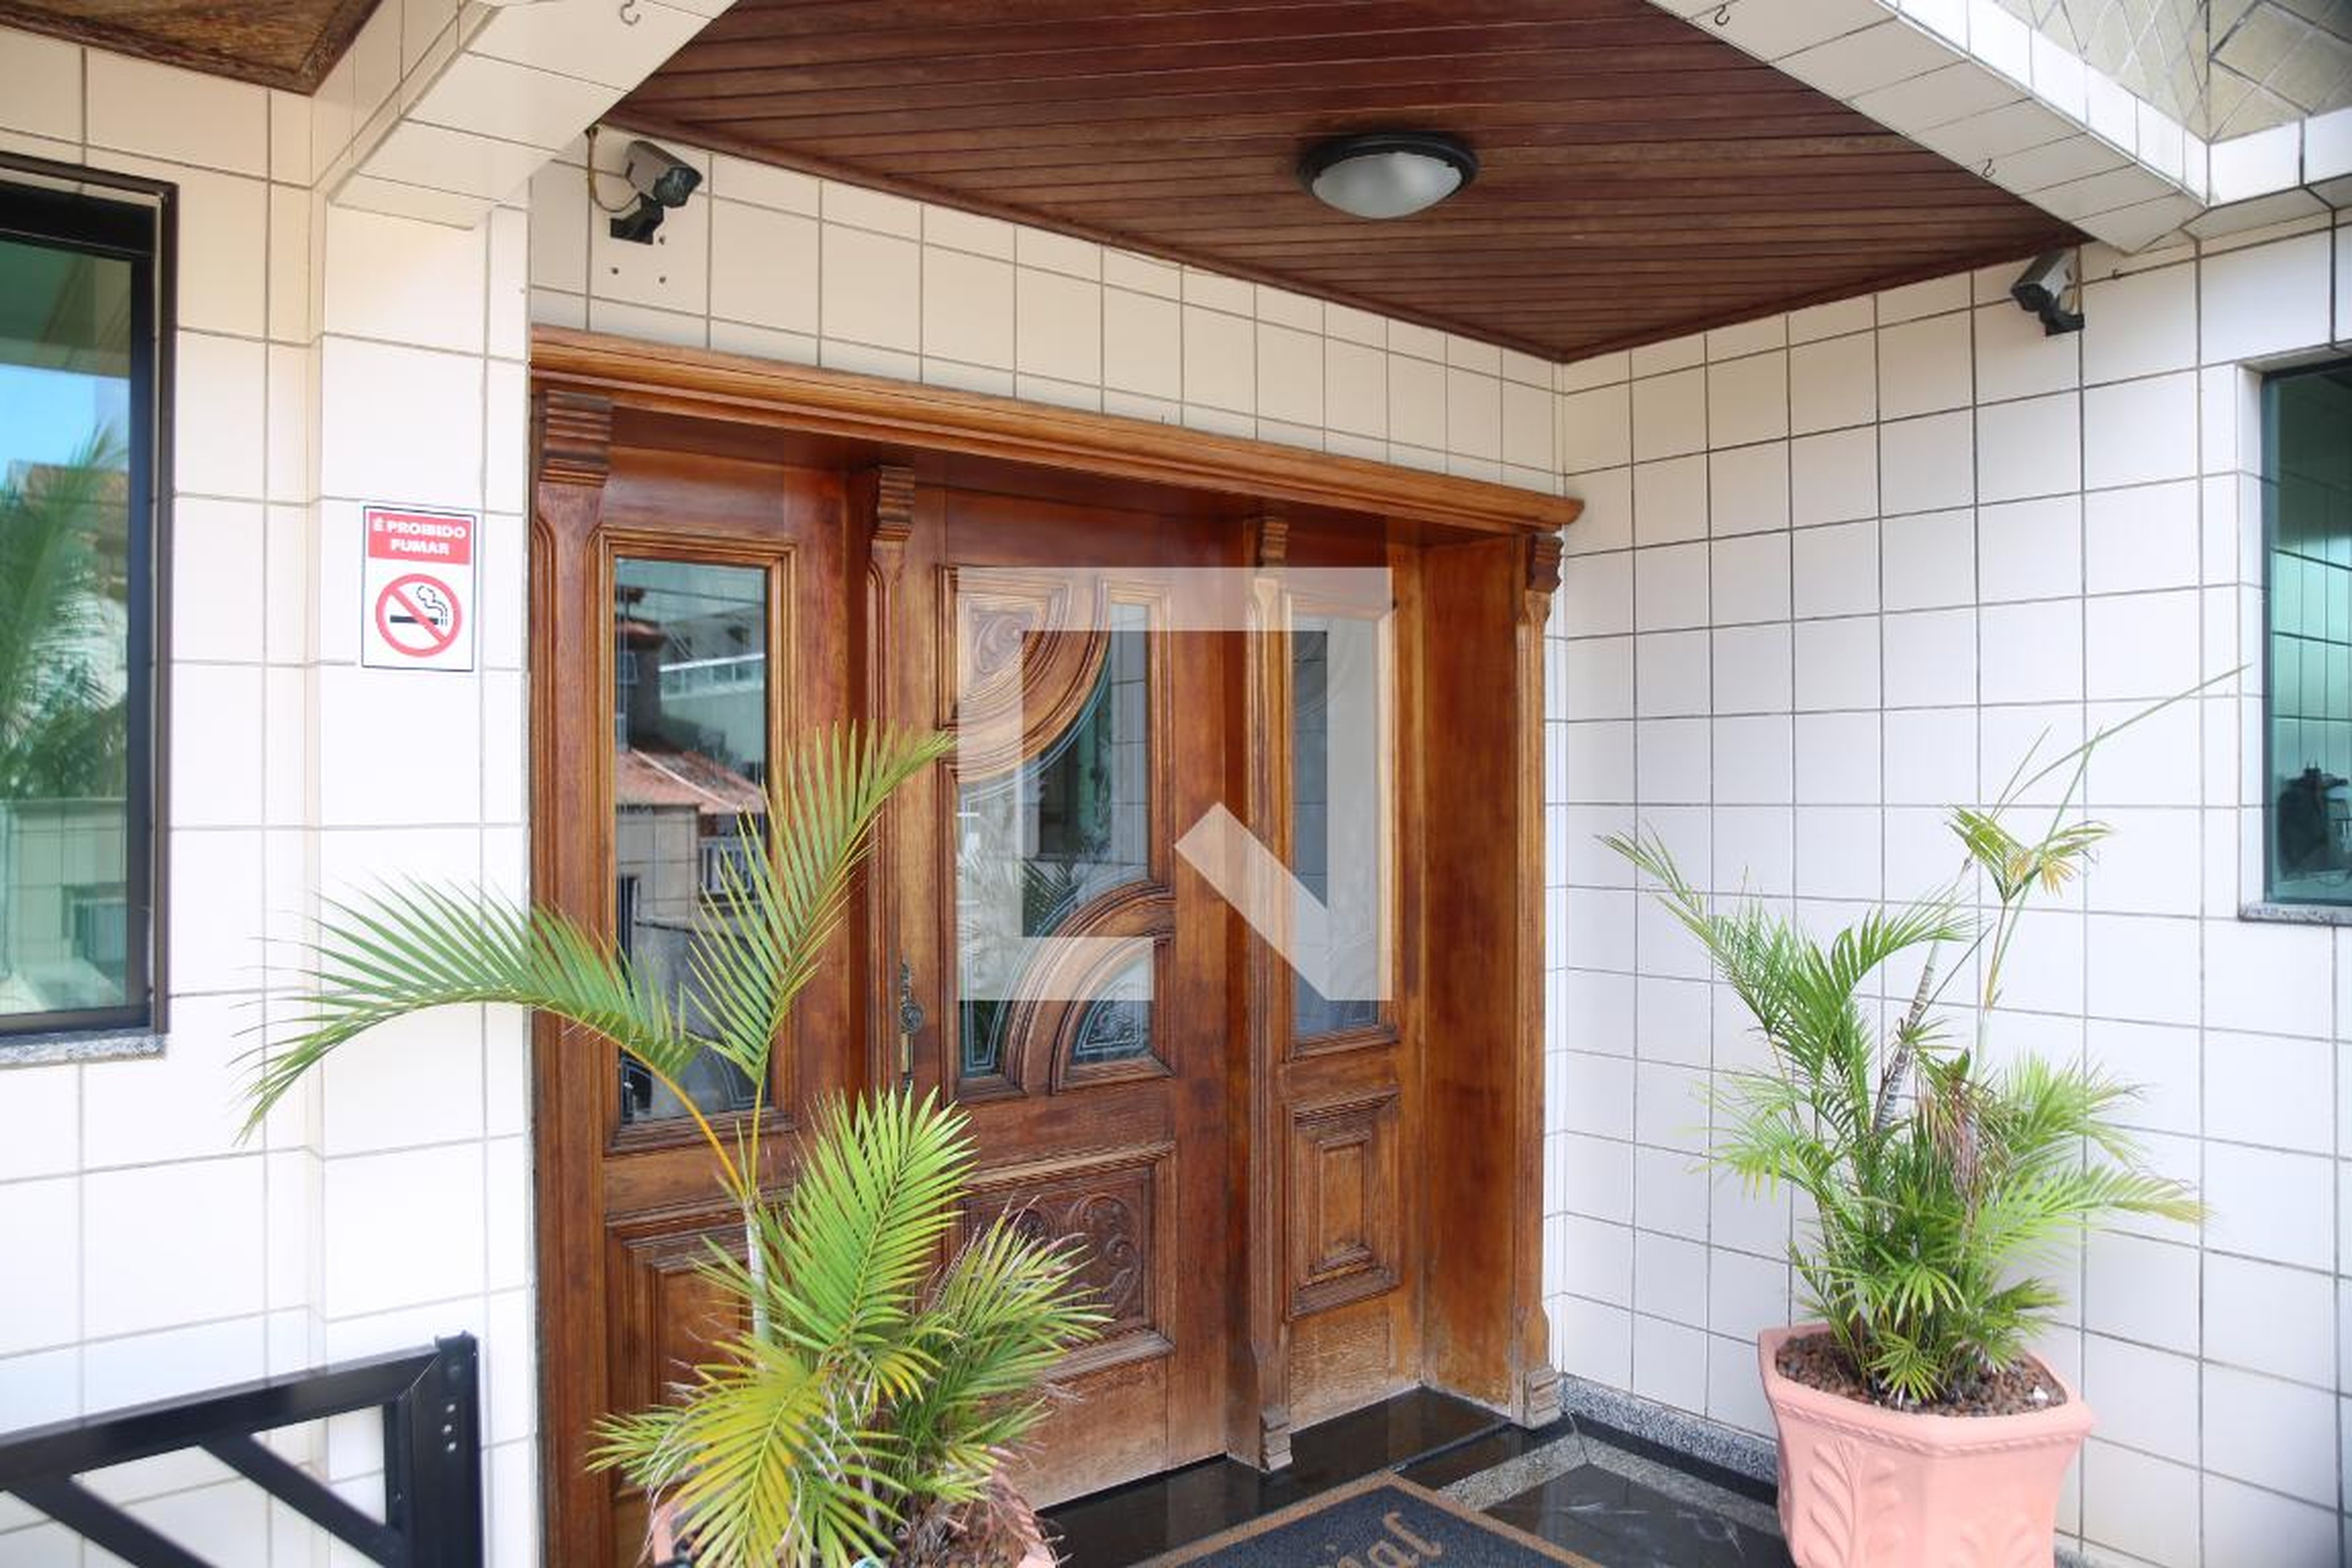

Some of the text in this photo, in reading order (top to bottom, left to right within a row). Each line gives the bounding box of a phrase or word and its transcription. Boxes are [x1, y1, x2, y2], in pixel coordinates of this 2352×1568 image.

[373, 517, 466, 538] É PROIBIDO
[391, 538, 450, 556] FUMAR
